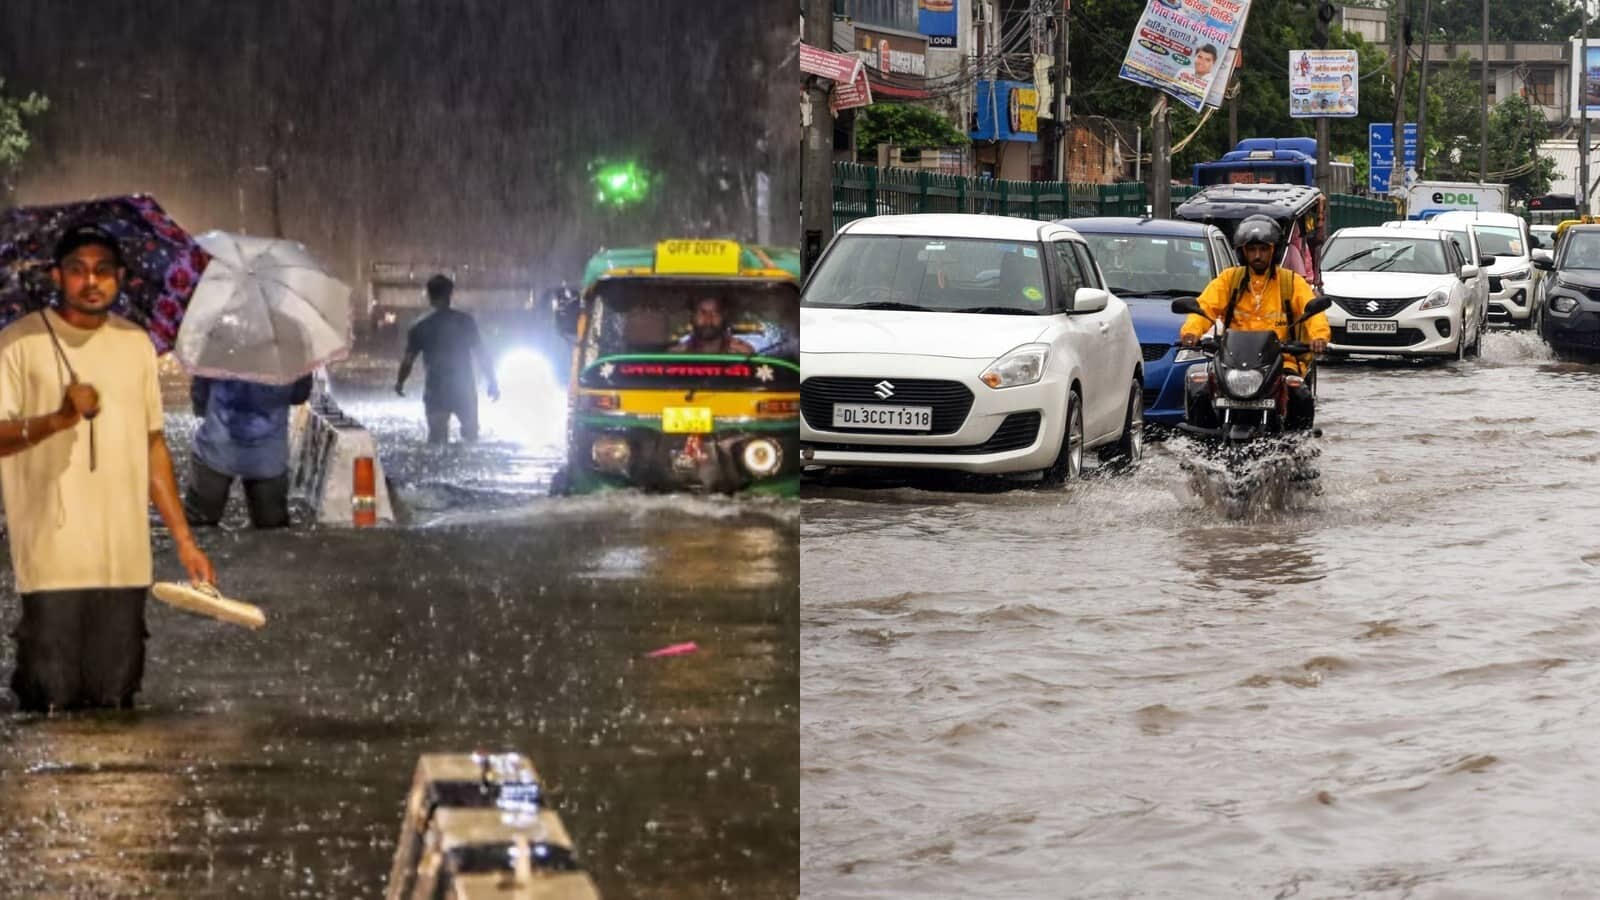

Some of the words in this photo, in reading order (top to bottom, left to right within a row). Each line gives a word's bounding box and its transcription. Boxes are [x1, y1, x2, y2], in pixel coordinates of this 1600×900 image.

[667, 242, 690, 256] OFF
[694, 242, 727, 256] DUTY
[843, 408, 929, 426] DL3CCT1318
